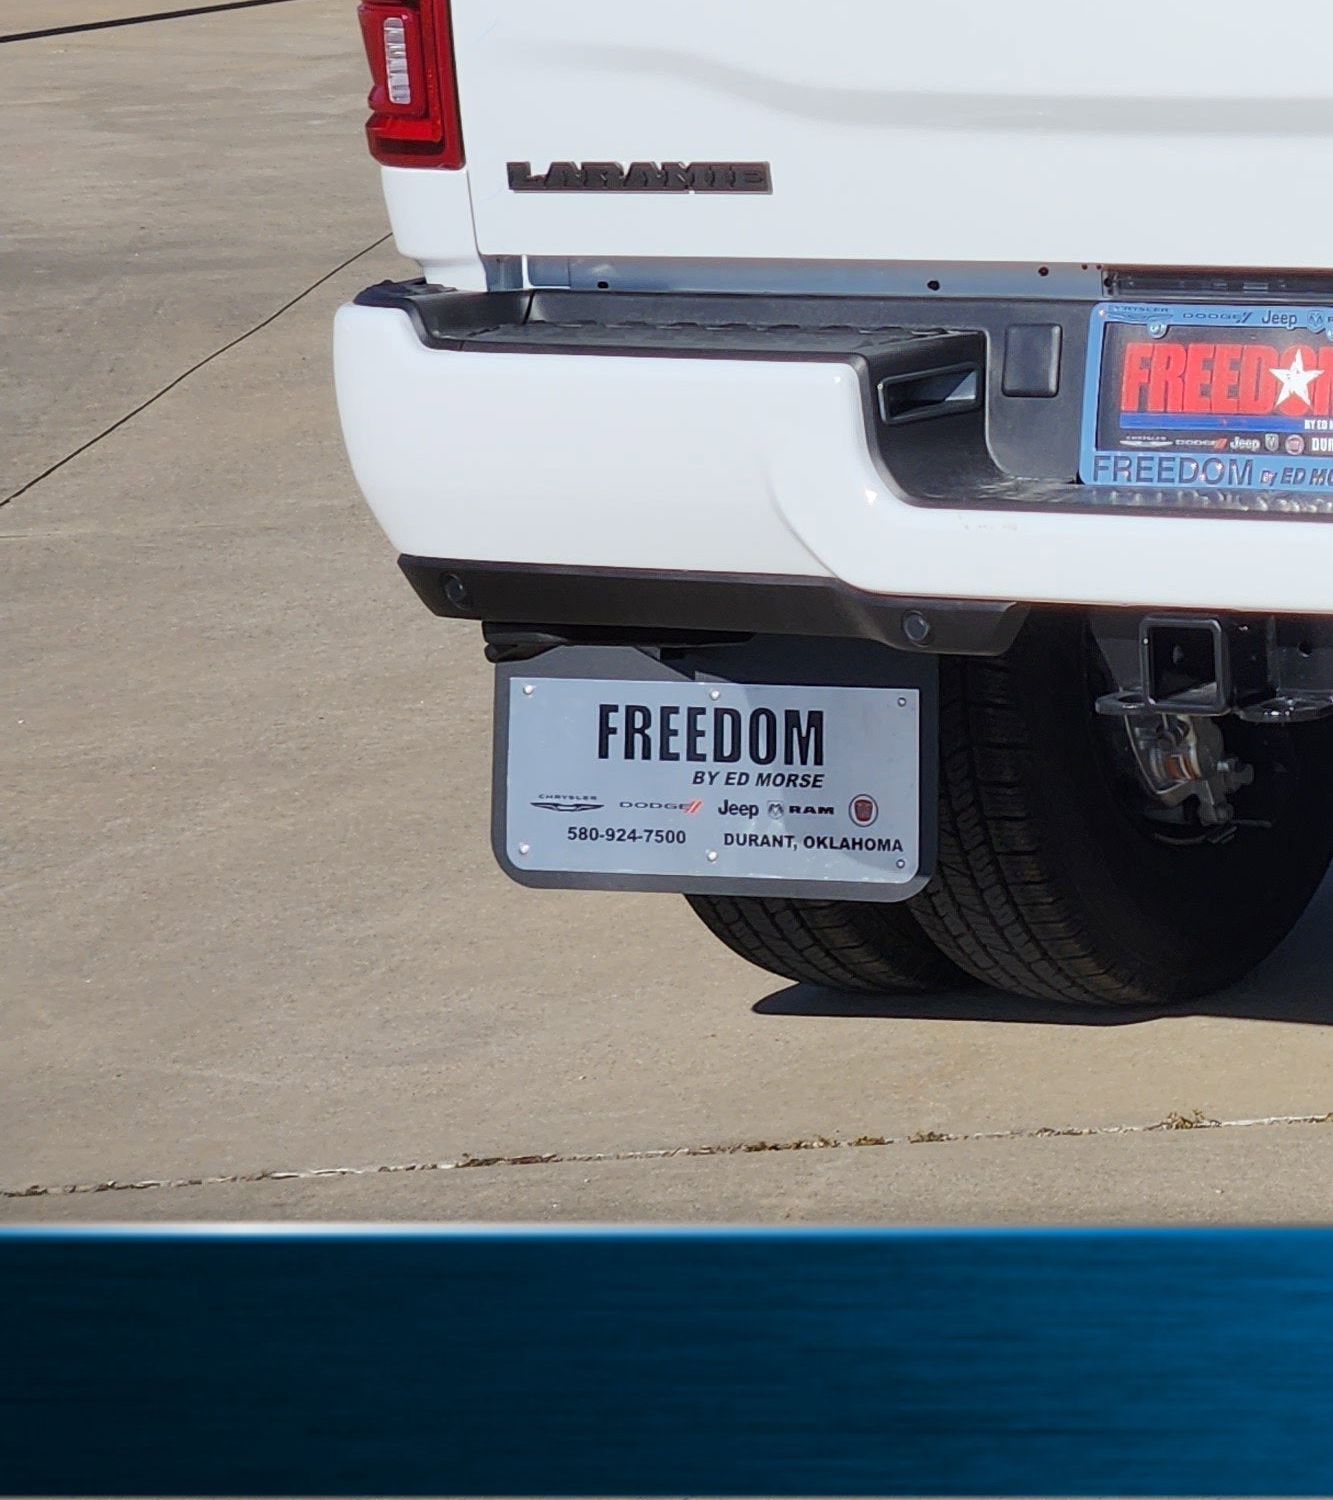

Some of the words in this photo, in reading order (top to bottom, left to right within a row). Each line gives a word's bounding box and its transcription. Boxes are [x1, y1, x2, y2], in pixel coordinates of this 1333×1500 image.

[506, 161, 773, 195] LARAMIE
[1261, 309, 1298, 330] Jeep
[1092, 455, 1254, 486] FREEDOM
[1280, 467, 1306, 485] ED
[597, 703, 825, 767] FREEDOM
[691, 770, 720, 787] BY
[723, 771, 750, 787] ED
[754, 772, 825, 789] MORSE
[717, 799, 760, 820] Jeep
[788, 804, 835, 816] RAM
[566, 826, 687, 845] 580-924-7500
[723, 832, 798, 852] DURANT,
[802, 835, 904, 853] OKLAHOMA
